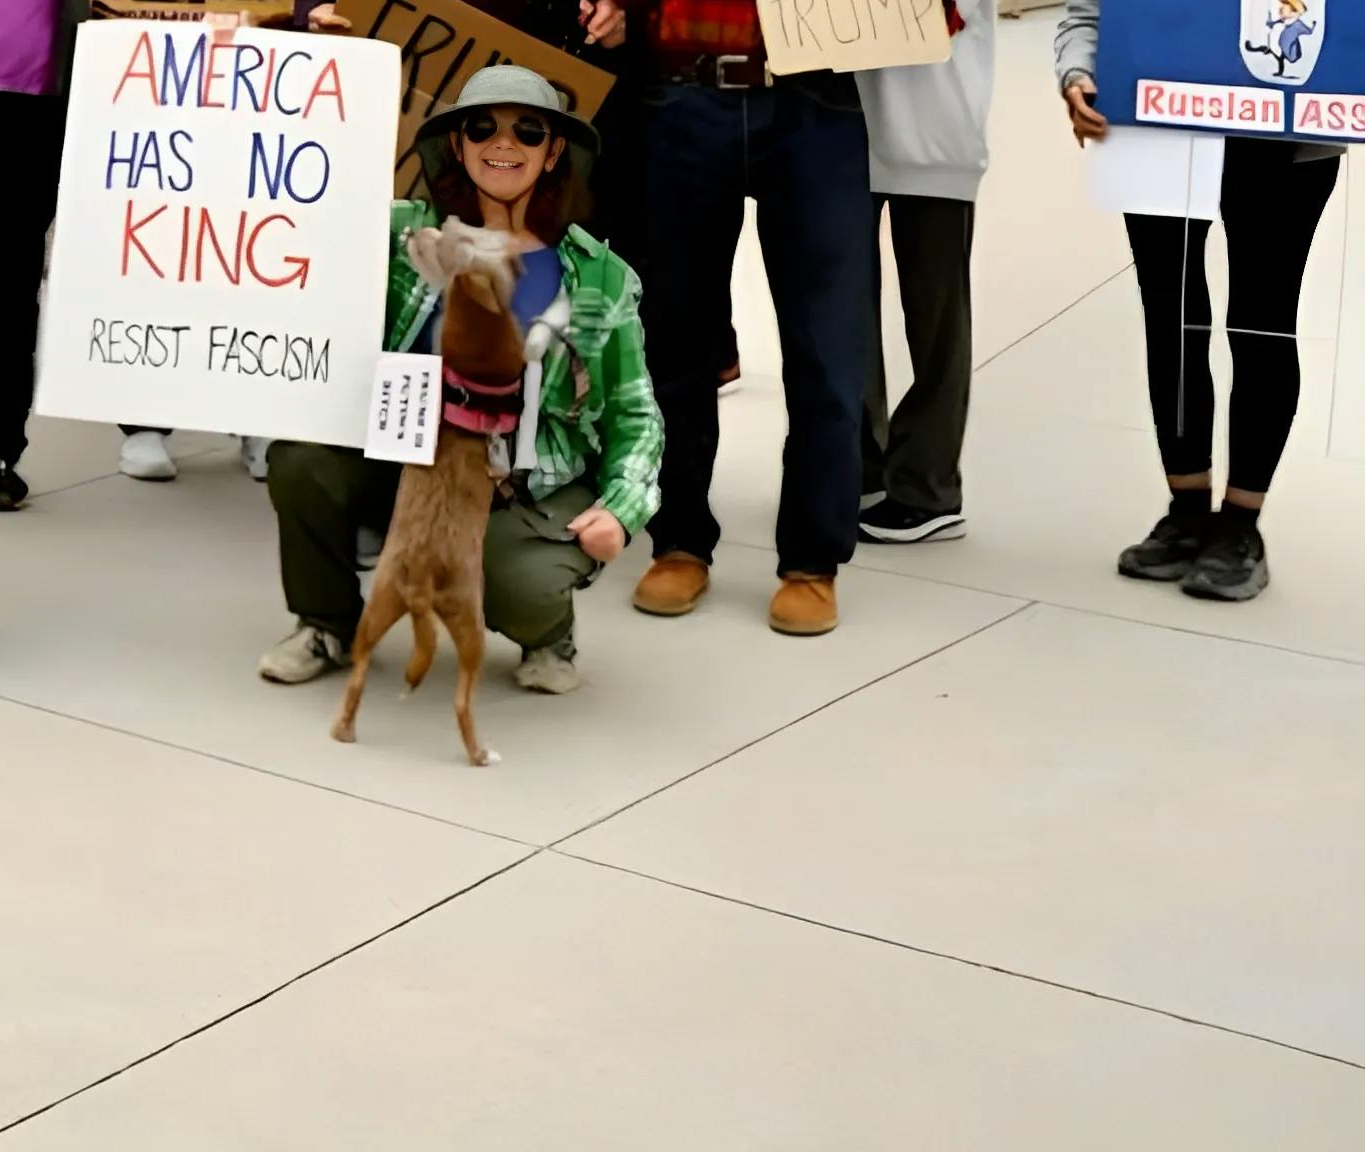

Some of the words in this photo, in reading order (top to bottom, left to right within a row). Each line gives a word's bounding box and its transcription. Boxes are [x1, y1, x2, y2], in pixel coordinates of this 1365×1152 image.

[112, 30, 346, 122] AMERICA
[1143, 85, 1281, 124] Russian
[105, 130, 194, 191] HAS
[248, 132, 330, 203] NO
[121, 199, 310, 290] KING
[89, 318, 191, 369] RESIST
[207, 325, 331, 383] FASCISM
